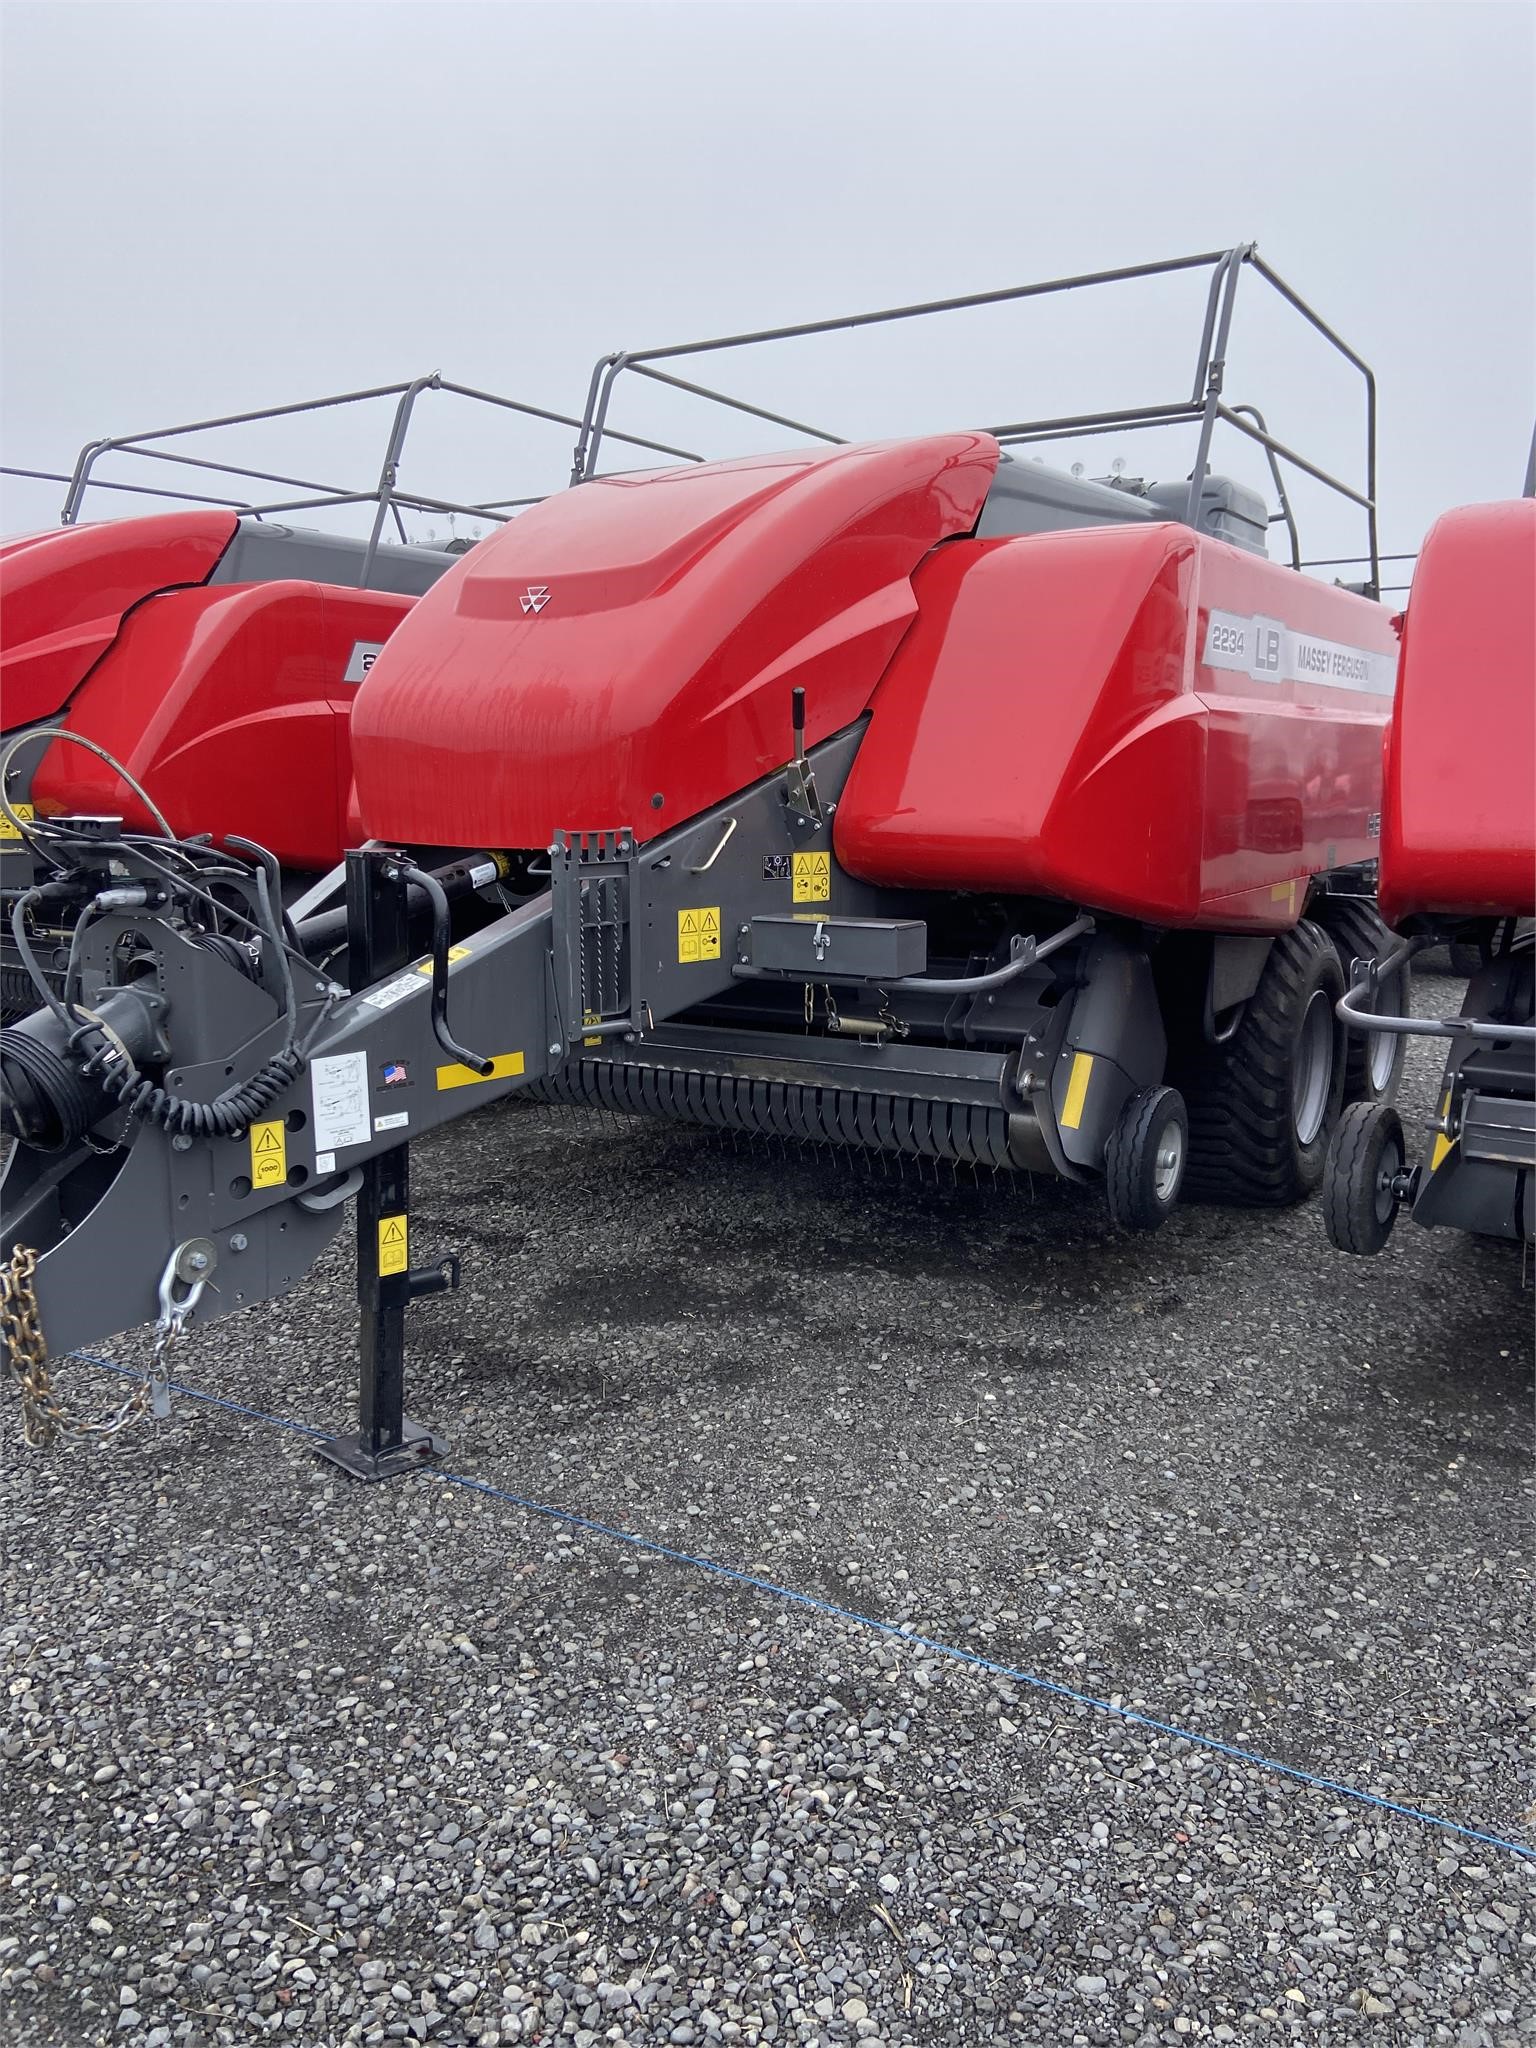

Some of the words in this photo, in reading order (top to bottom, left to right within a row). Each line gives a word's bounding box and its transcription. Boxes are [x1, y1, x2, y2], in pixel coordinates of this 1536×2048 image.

[1212, 625, 1245, 654] 2234
[1255, 627, 1280, 671] LB
[1298, 645, 1331, 674] MASSEY
[1332, 653, 1369, 681] FERGUSON
[261, 1165, 278, 1173] 1000
